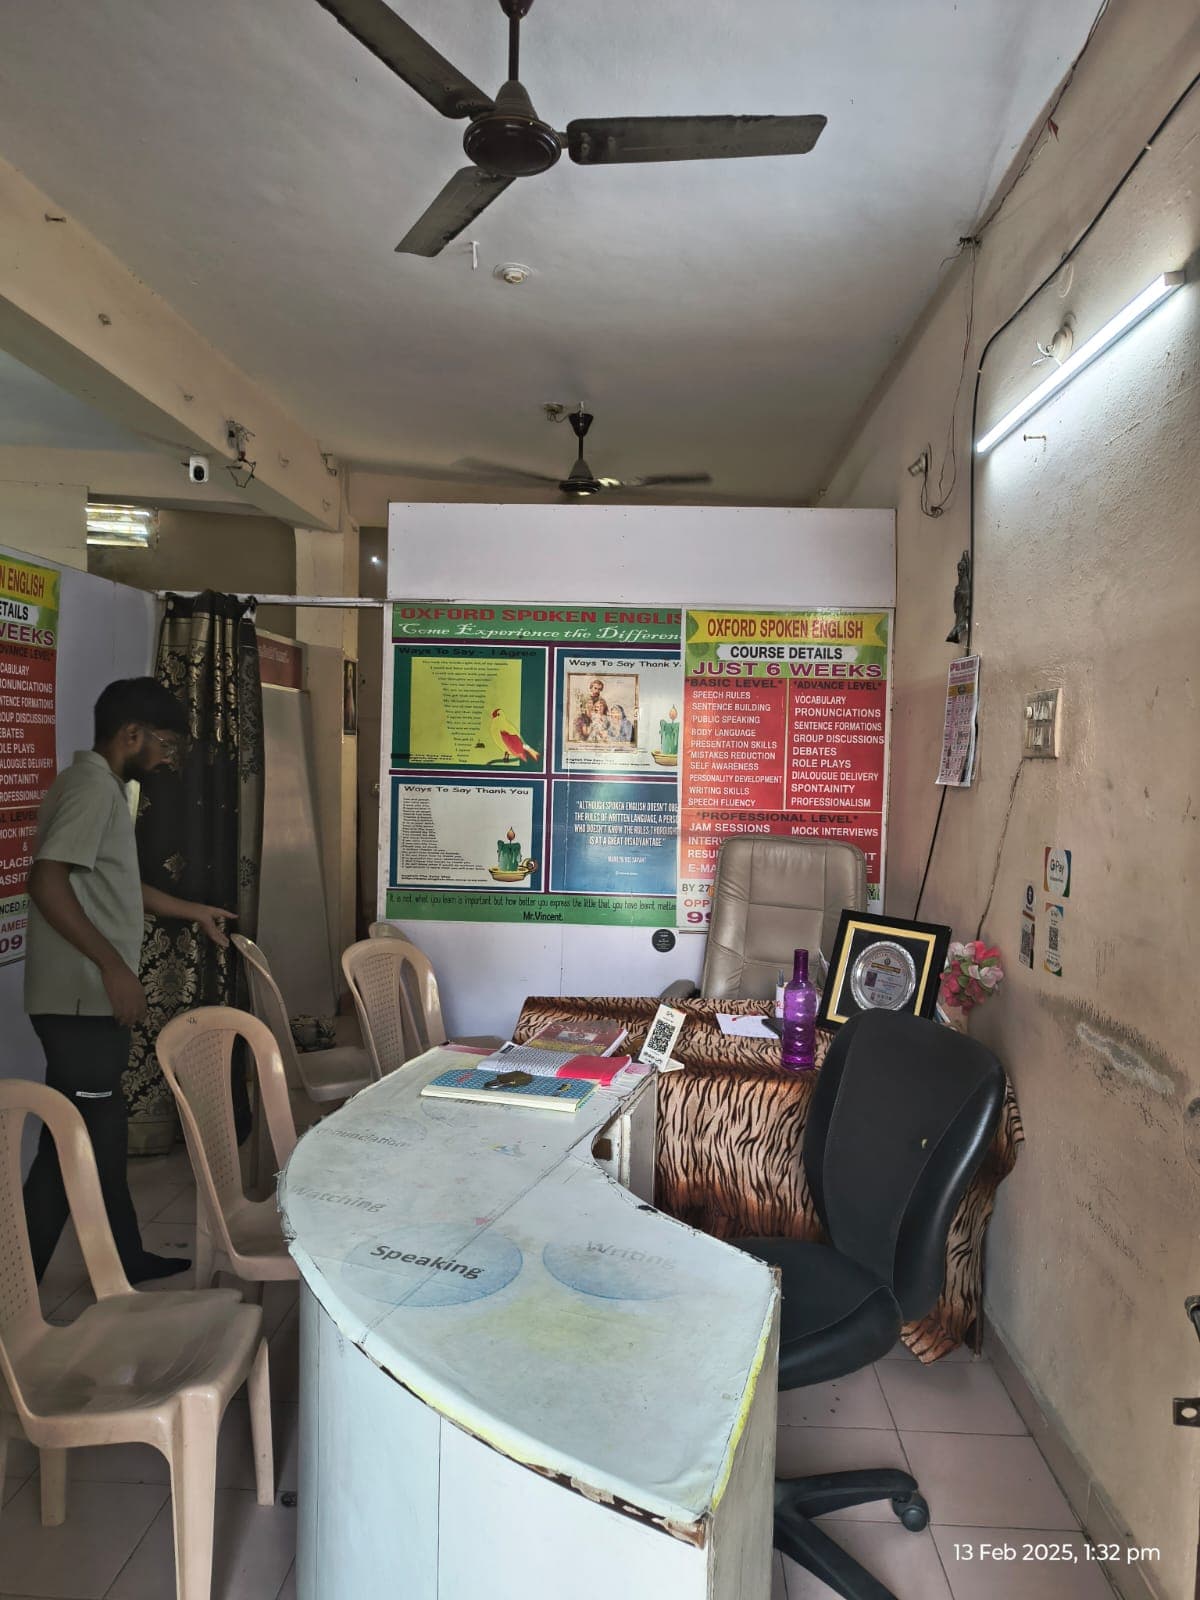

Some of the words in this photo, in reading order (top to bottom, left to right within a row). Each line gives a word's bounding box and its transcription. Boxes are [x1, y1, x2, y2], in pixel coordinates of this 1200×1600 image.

[8, 567, 45, 598] ENGLISH
[400, 607, 495, 621] OXFORD
[502, 608, 597, 623] SPOKEN
[399, 622, 451, 636] Come
[455, 623, 560, 640] Experience
[564, 626, 592, 639] the
[596, 625, 683, 643] Differen
[707, 618, 757, 638] OXFORD
[760, 619, 808, 639] SPOKEN
[812, 619, 864, 639] ENGLISH
[730, 646, 785, 659] COURSE
[789, 647, 843, 660] DETAILS
[568, 659, 597, 668] Ways
[616, 660, 636, 668] Say
[641, 660, 670, 668] Thank
[693, 661, 758, 676] JUST
[766, 662, 781, 677] 6
[789, 662, 882, 678] WEEKS
[692, 690, 724, 699] SPEECH
[725, 691, 751, 700] RULES
[794, 695, 847, 705] VOCABULARY
[21, 697, 54, 710] FORMATIONS
[691, 702, 732, 711] SENTENCE
[734, 703, 771, 712] BUILDING
[794, 708, 881, 718] PRONUNCIATIONS
[16, 713, 56, 725] DISCUSSIONS
[692, 715, 720, 724] PUBLIC
[721, 716, 761, 724] SPEAKING
[794, 721, 833, 731] SENTENCE
[834, 722, 882, 731] FORMATIONS
[691, 728, 712, 737] BODY
[714, 728, 757, 737] LANGUAGE
[793, 734, 825, 744] GROUP
[826, 735, 885, 745] DISCUSSIONS
[14, 743, 35, 754] PLAYS
[690, 740, 749, 749] PRESENTATION
[750, 741, 778, 750] SKILLS
[690, 751, 729, 760] MISTAKES
[730, 752, 776, 761] REDUCTION
[792, 747, 837, 756] DEBATES
[28, 758, 54, 769] DELIVERY
[690, 761, 710, 770] SELF
[711, 762, 759, 771] AWARENESS
[792, 759, 817, 768] ROLE
[820, 760, 852, 769] PLAYS
[689, 774, 733, 783] PERSONALITY
[734, 775, 783, 784] DEVELOPMENT
[791, 771, 838, 781] DIALOUGUE
[840, 772, 879, 782] DELIVERY
[403, 785, 432, 793] Ways
[451, 787, 472, 795] Say
[476, 787, 507, 795] Thank
[688, 786, 722, 795] WRITING
[723, 787, 750, 796] SKILLS
[791, 784, 855, 794] SPONTAINITY
[688, 798, 719, 807] SPEECH
[720, 799, 756, 808] FLUENCY
[791, 797, 871, 808] PROFESSIONALISM
[689, 823, 711, 832] JAM
[714, 824, 771, 833] SESSIONS
[791, 827, 819, 836] MOCK
[821, 828, 879, 837] INTERVIEWS
[687, 849, 719, 859] RESU
[0, 872, 30, 886] ASSIT
[682, 883, 696, 892] BY
[369, 1242, 485, 1280] Speaking
